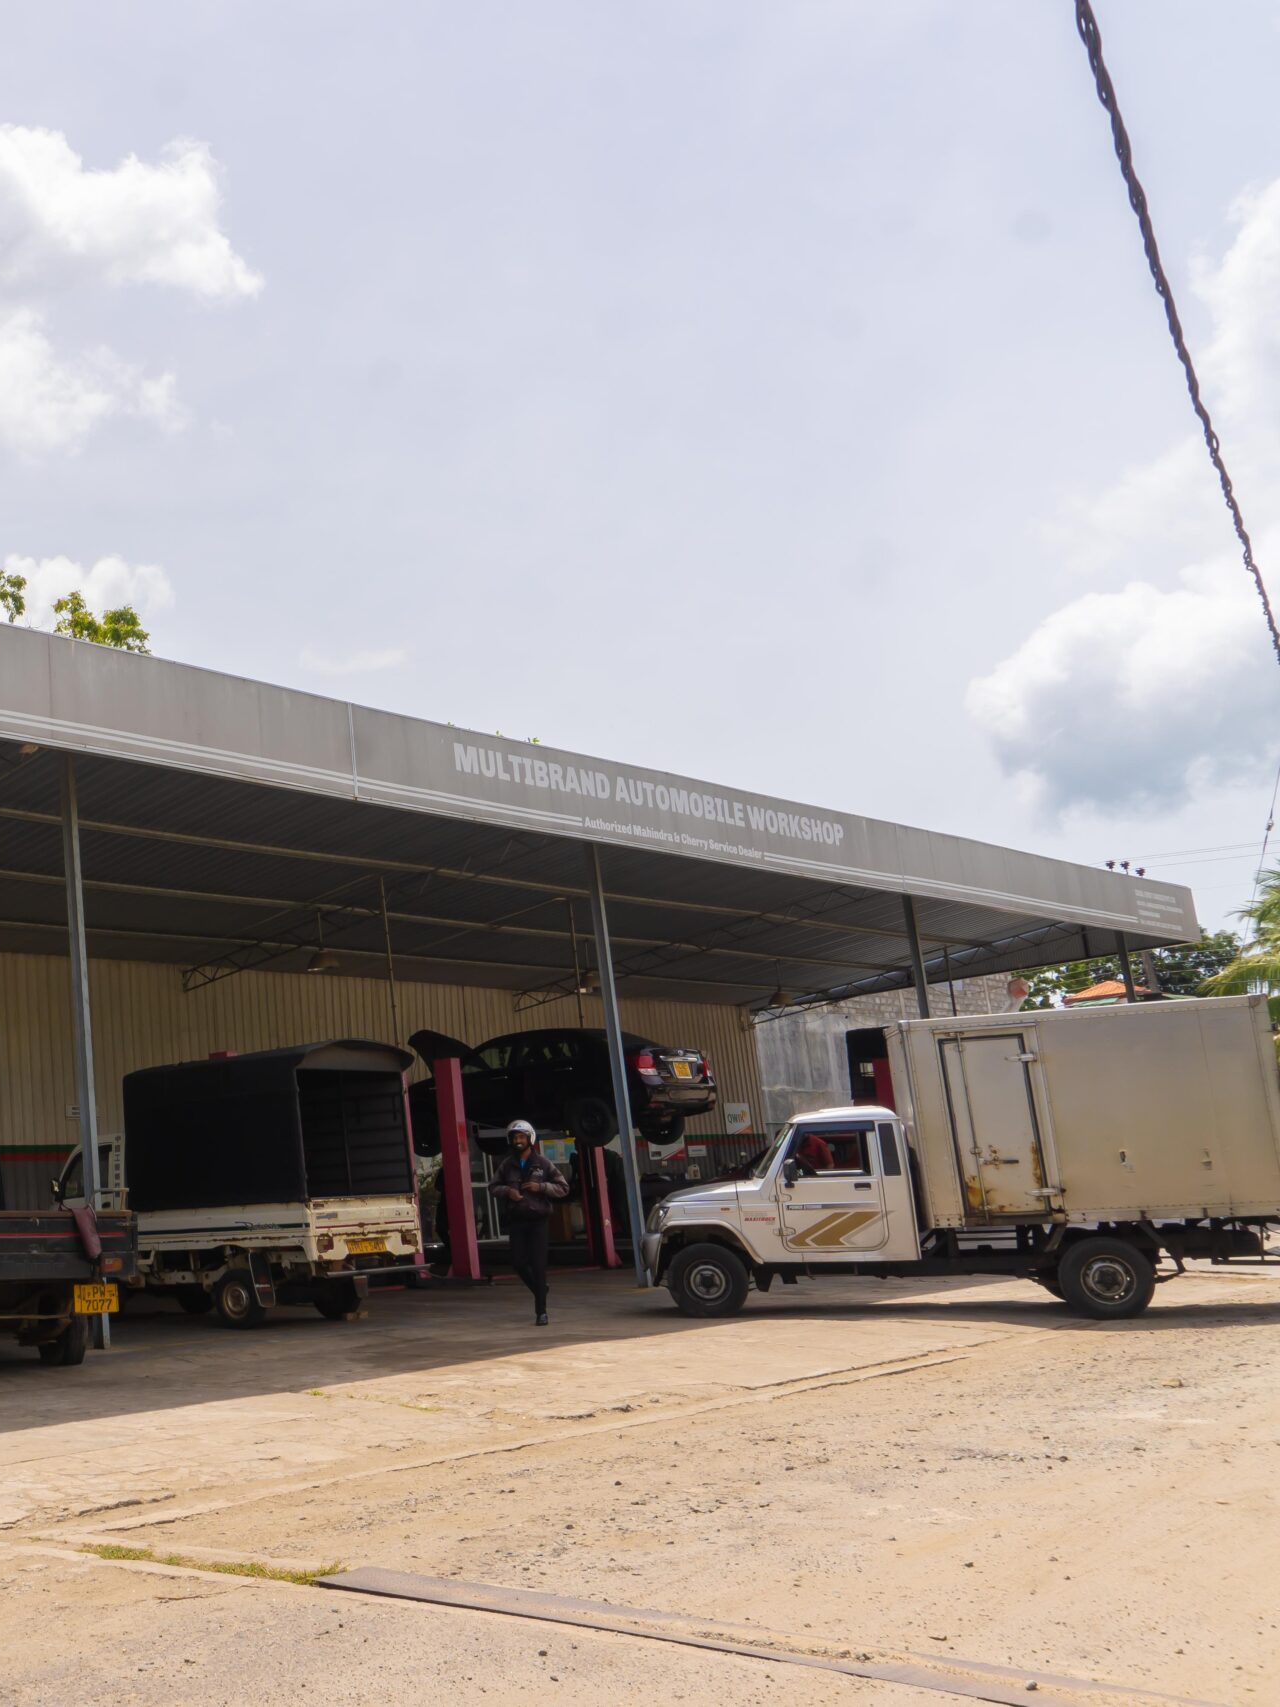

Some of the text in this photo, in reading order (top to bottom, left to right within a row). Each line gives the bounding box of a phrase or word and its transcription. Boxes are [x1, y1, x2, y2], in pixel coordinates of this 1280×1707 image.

[452, 742, 844, 847] MULTIBRAND AUTOMOBILE WORKSHOP
[584, 816, 632, 835] Authorized
[632, 824, 673, 842] Mahindra
[680, 833, 708, 850] Cherry
[708, 839, 738, 854] Service
[738, 845, 763, 859] Dealer
[86, 1298, 113, 1312] 7077
